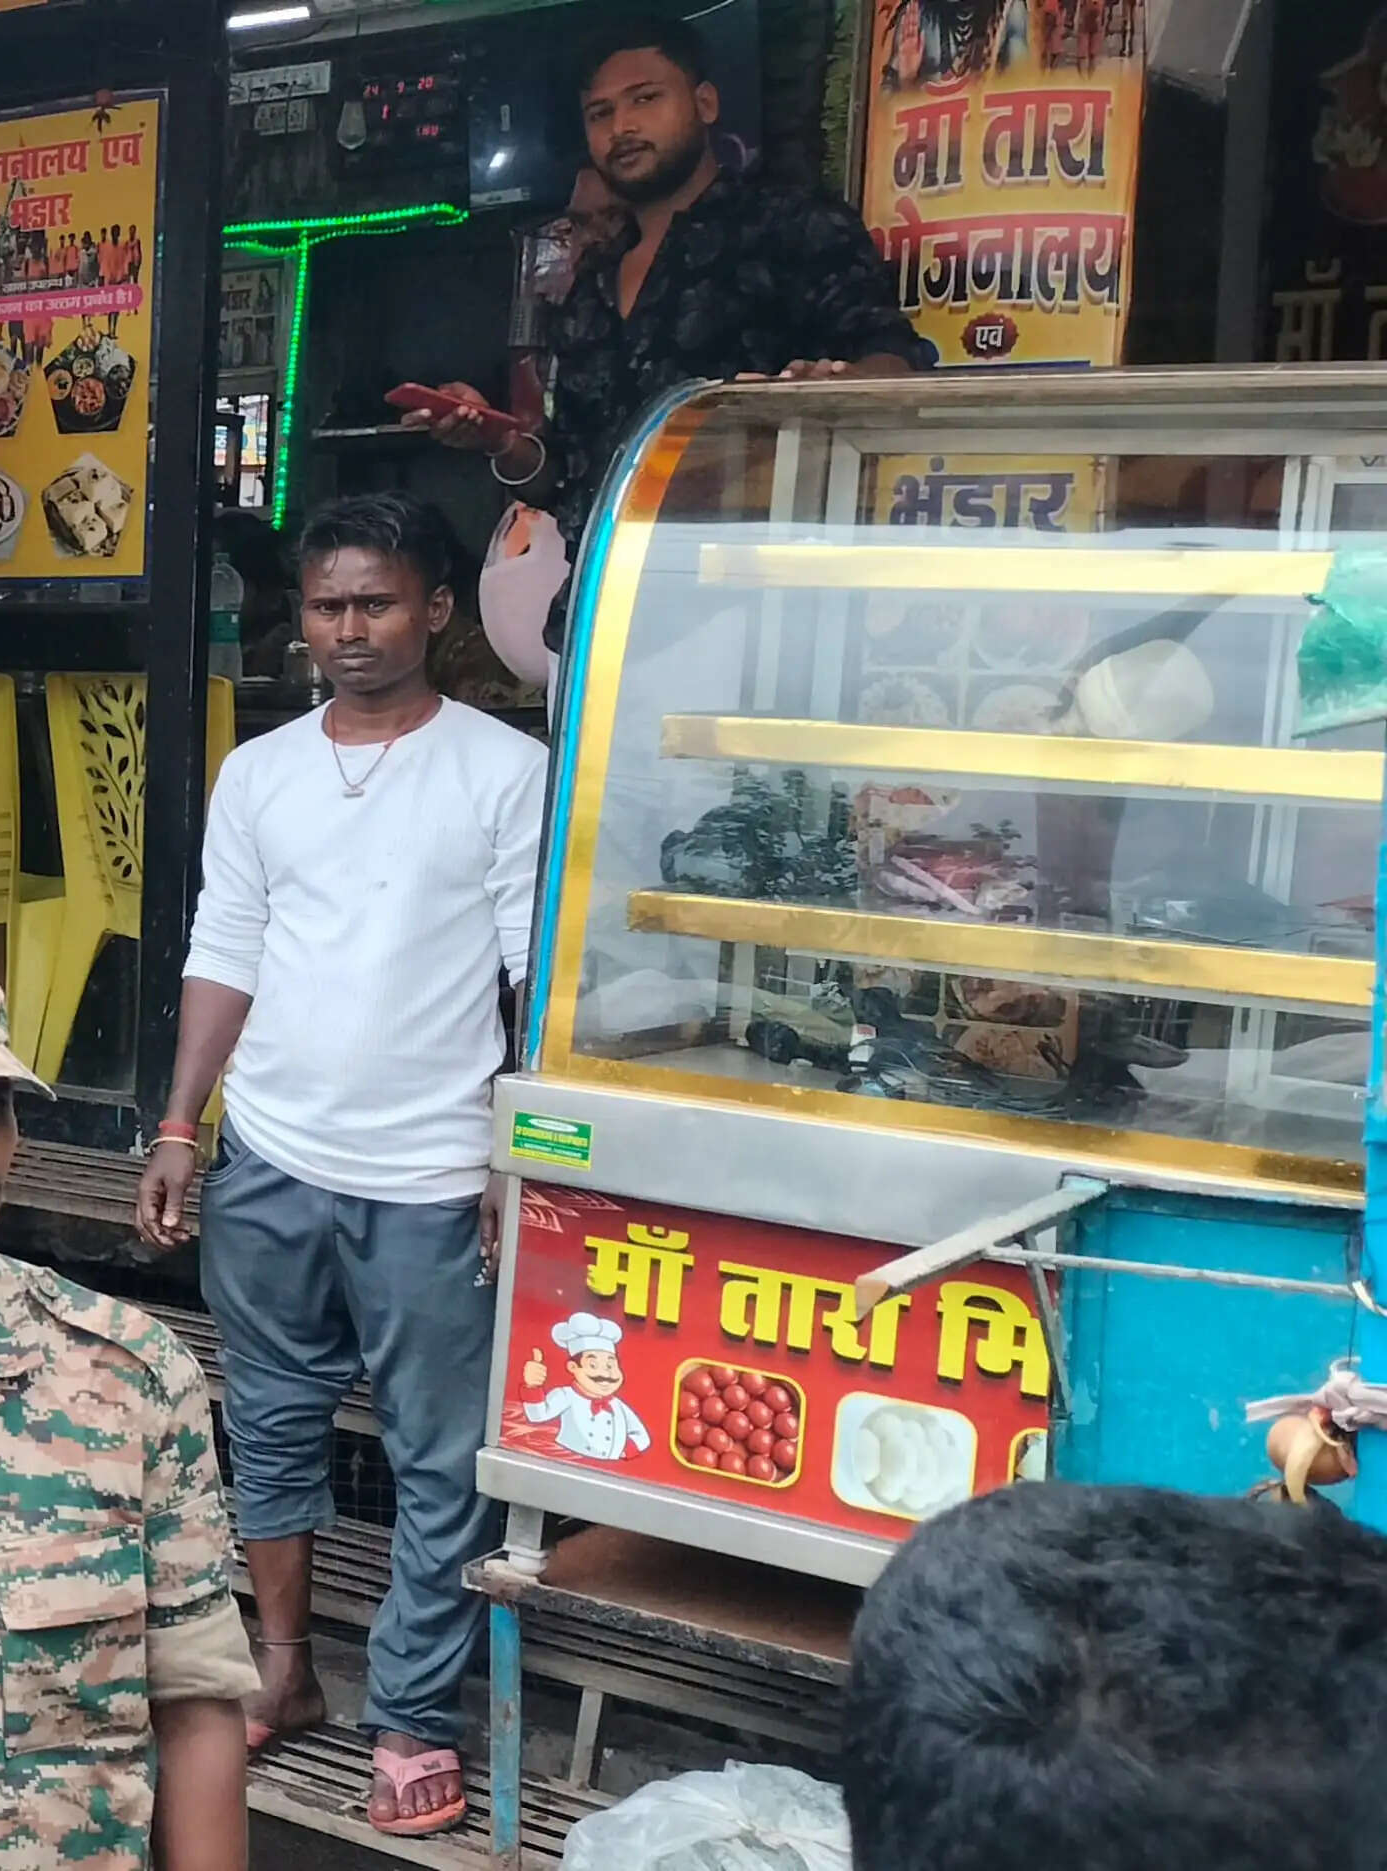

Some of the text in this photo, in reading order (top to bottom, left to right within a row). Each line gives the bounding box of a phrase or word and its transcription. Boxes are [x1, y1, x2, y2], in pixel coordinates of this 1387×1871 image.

[99, 121, 145, 169] एवं
[983, 90, 1112, 182] तारा
[975, 316, 1005, 350] एवं
[889, 455, 1074, 532] भंडार
[718, 1260, 912, 1368] तारा
